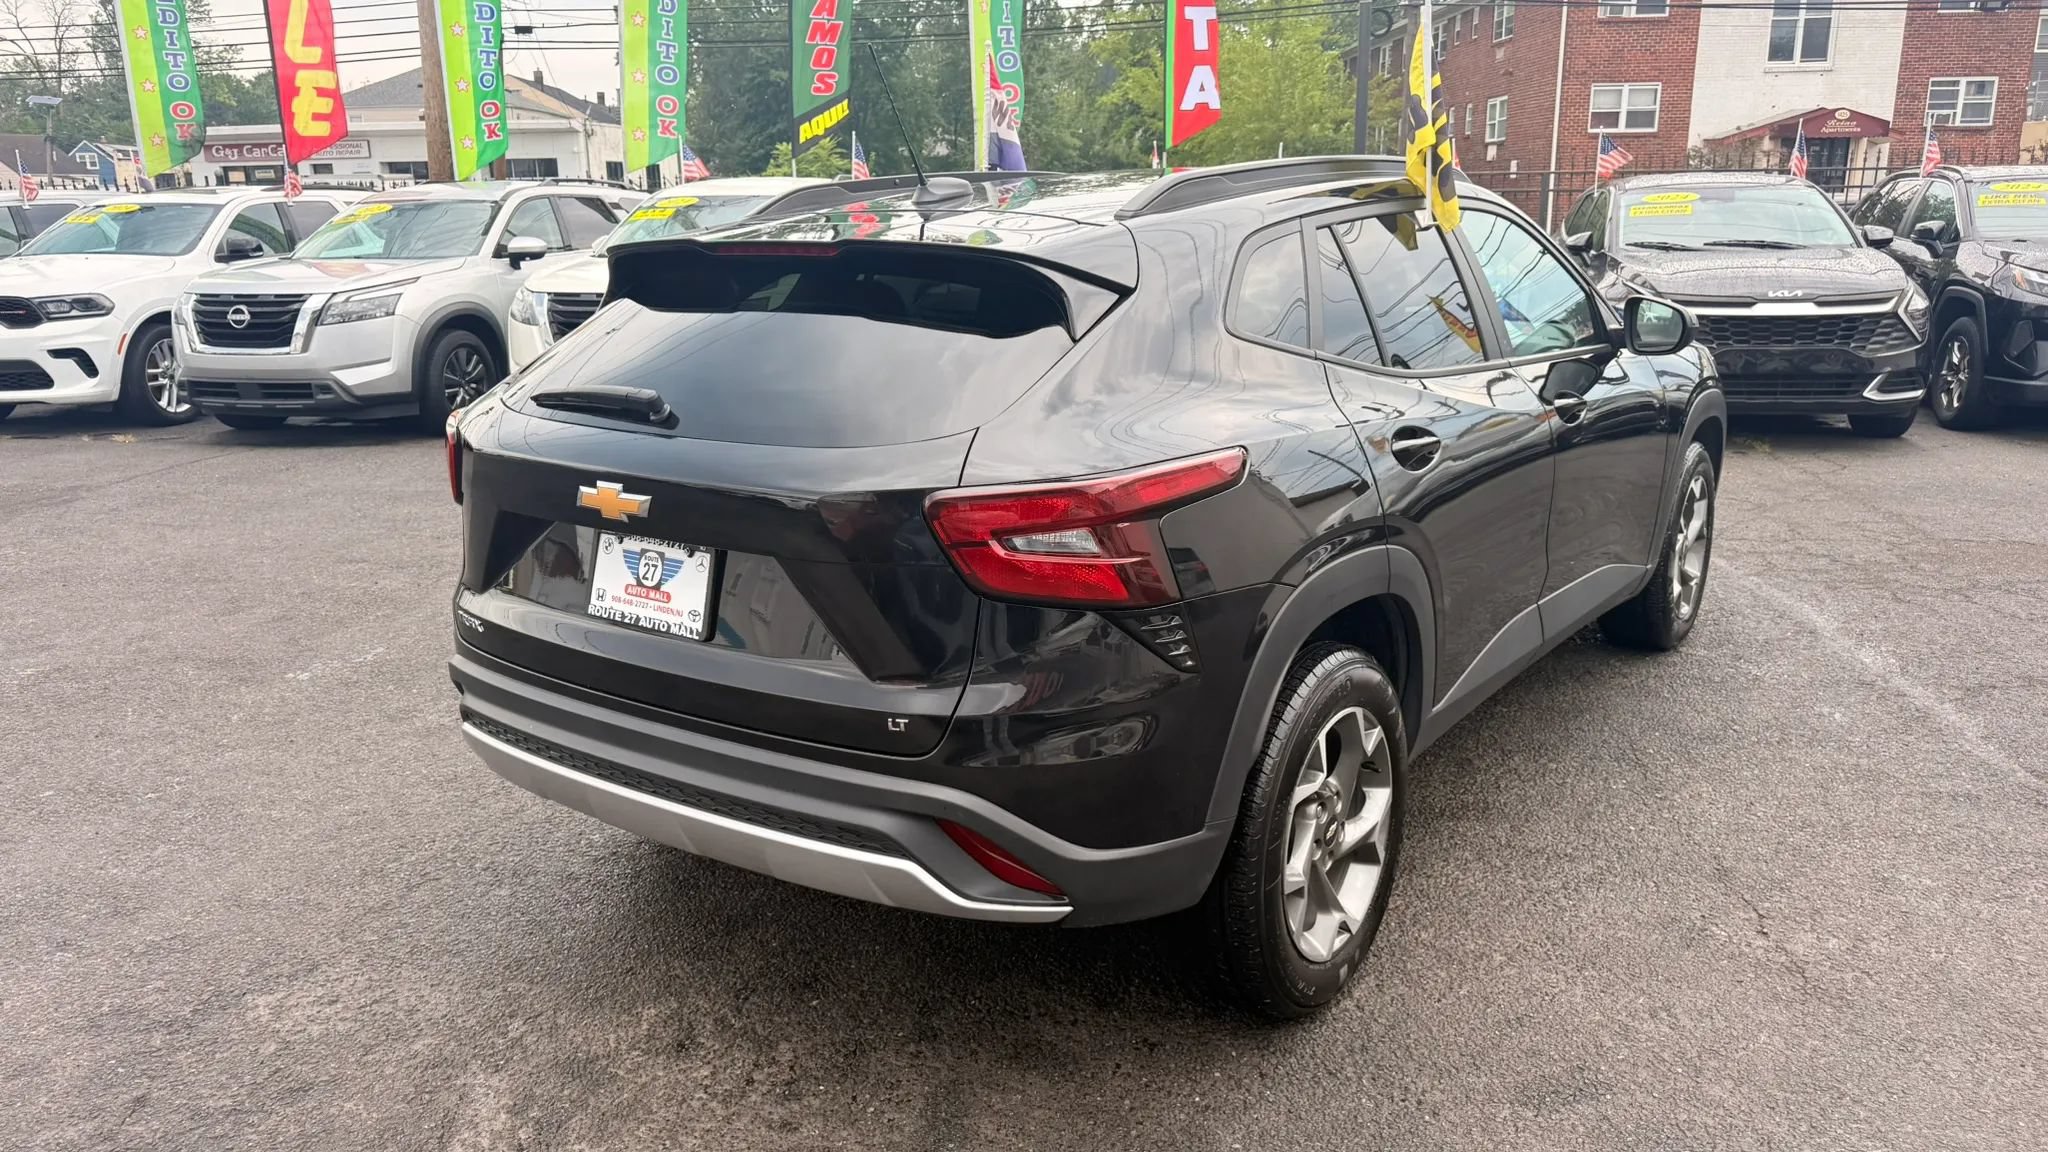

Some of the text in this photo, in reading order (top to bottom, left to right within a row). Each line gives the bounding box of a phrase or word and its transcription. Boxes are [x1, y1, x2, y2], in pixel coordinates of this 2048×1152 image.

[805, 0, 844, 96] AMOS
[156, 0, 197, 141] DITO OK
[473, 2, 503, 142] DITO OK
[655, 95, 680, 139] OK
[641, 562, 659, 583] 27
[644, 554, 660, 564] ROUTE
[626, 585, 669, 602] AUTO MALL
[588, 604, 700, 640] ROUTE 27 AUTO MALL
[887, 718, 909, 731] LT
